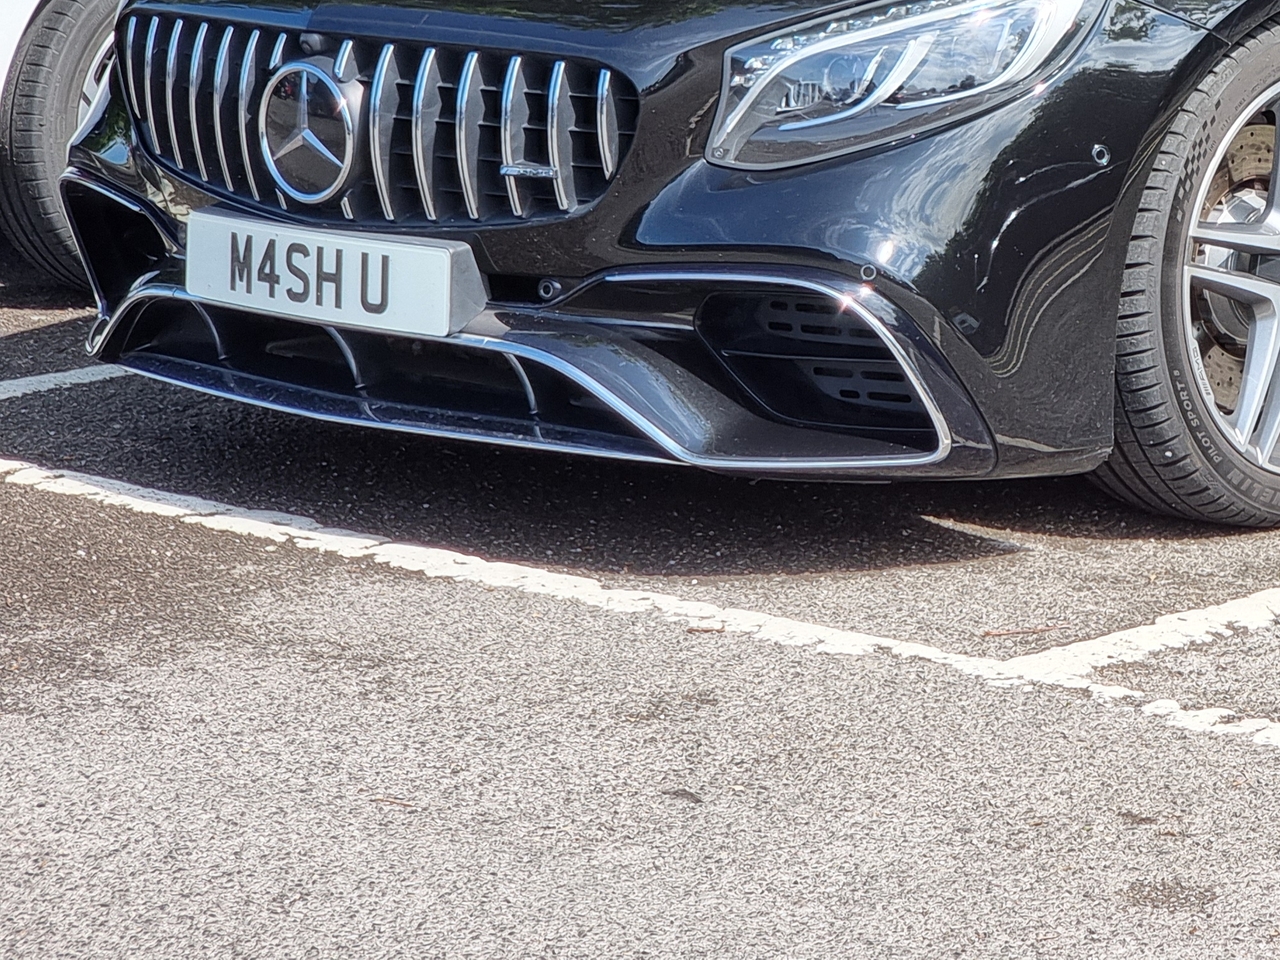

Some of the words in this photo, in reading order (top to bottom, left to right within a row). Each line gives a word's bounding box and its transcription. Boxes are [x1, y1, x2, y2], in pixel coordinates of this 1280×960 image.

[229, 231, 344, 310] M4SH
[360, 251, 390, 315] U
[1175, 380, 1201, 428] SPORT
[1195, 430, 1224, 464] PILOT
